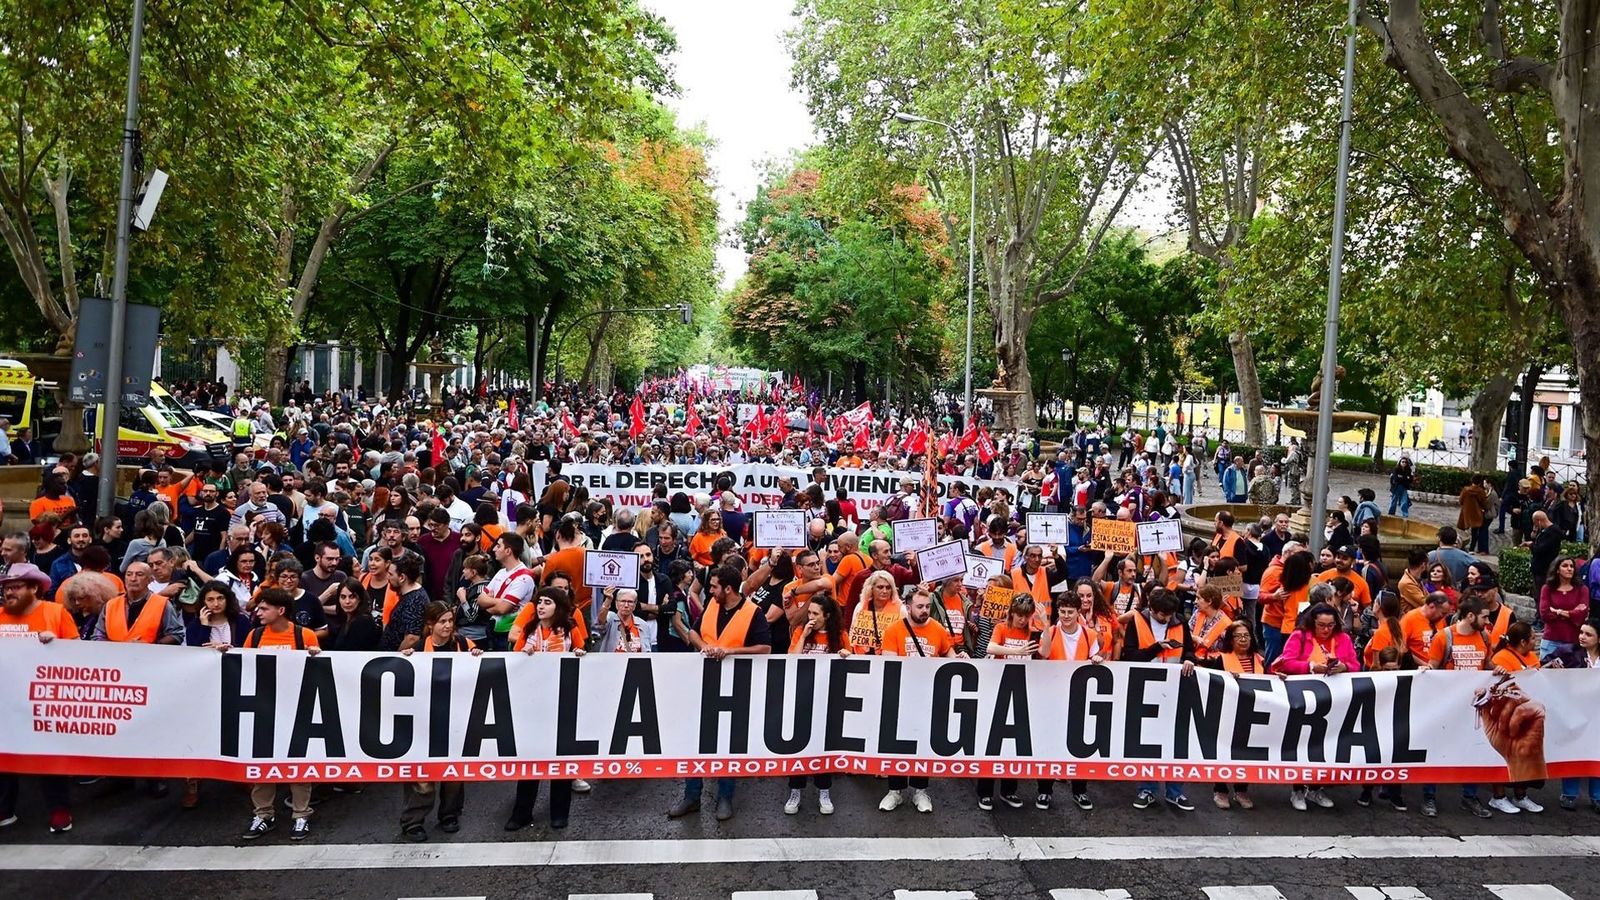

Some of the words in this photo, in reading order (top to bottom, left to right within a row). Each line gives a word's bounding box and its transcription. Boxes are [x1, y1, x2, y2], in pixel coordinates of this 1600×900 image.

[590, 475, 610, 488] EL
[744, 475, 755, 487] A
[1093, 533, 1110, 542] ESTAS
[1112, 536, 1129, 544] CASAS
[1093, 541, 1105, 549] SON
[852, 627, 882, 638] SEREMS
[36, 666, 121, 682] SINDICATO
[34, 684, 55, 699] DE
[58, 685, 145, 703] INQUILINAS
[33, 704, 41, 717] E
[45, 704, 133, 721] INQUILINOS
[220, 653, 518, 760] HACIA
[555, 657, 662, 756] LA
[698, 658, 1033, 757] HUELGA
[1065, 663, 1428, 765] GENERAL
[33, 720, 52, 733] DE
[56, 722, 117, 736] MADRID
[245, 764, 363, 780] BAJADA
[377, 763, 429, 779] DEL
[443, 762, 579, 779] ALQUILER
[592, 761, 643, 777] 50%
[676, 754, 868, 775] EXPROPIACIÓN
[880, 760, 981, 775] FONDOS
[992, 762, 1077, 777] BUITRE
[1107, 764, 1248, 780] CONTRATOS
[1258, 766, 1410, 782] INDEFINIDOS
